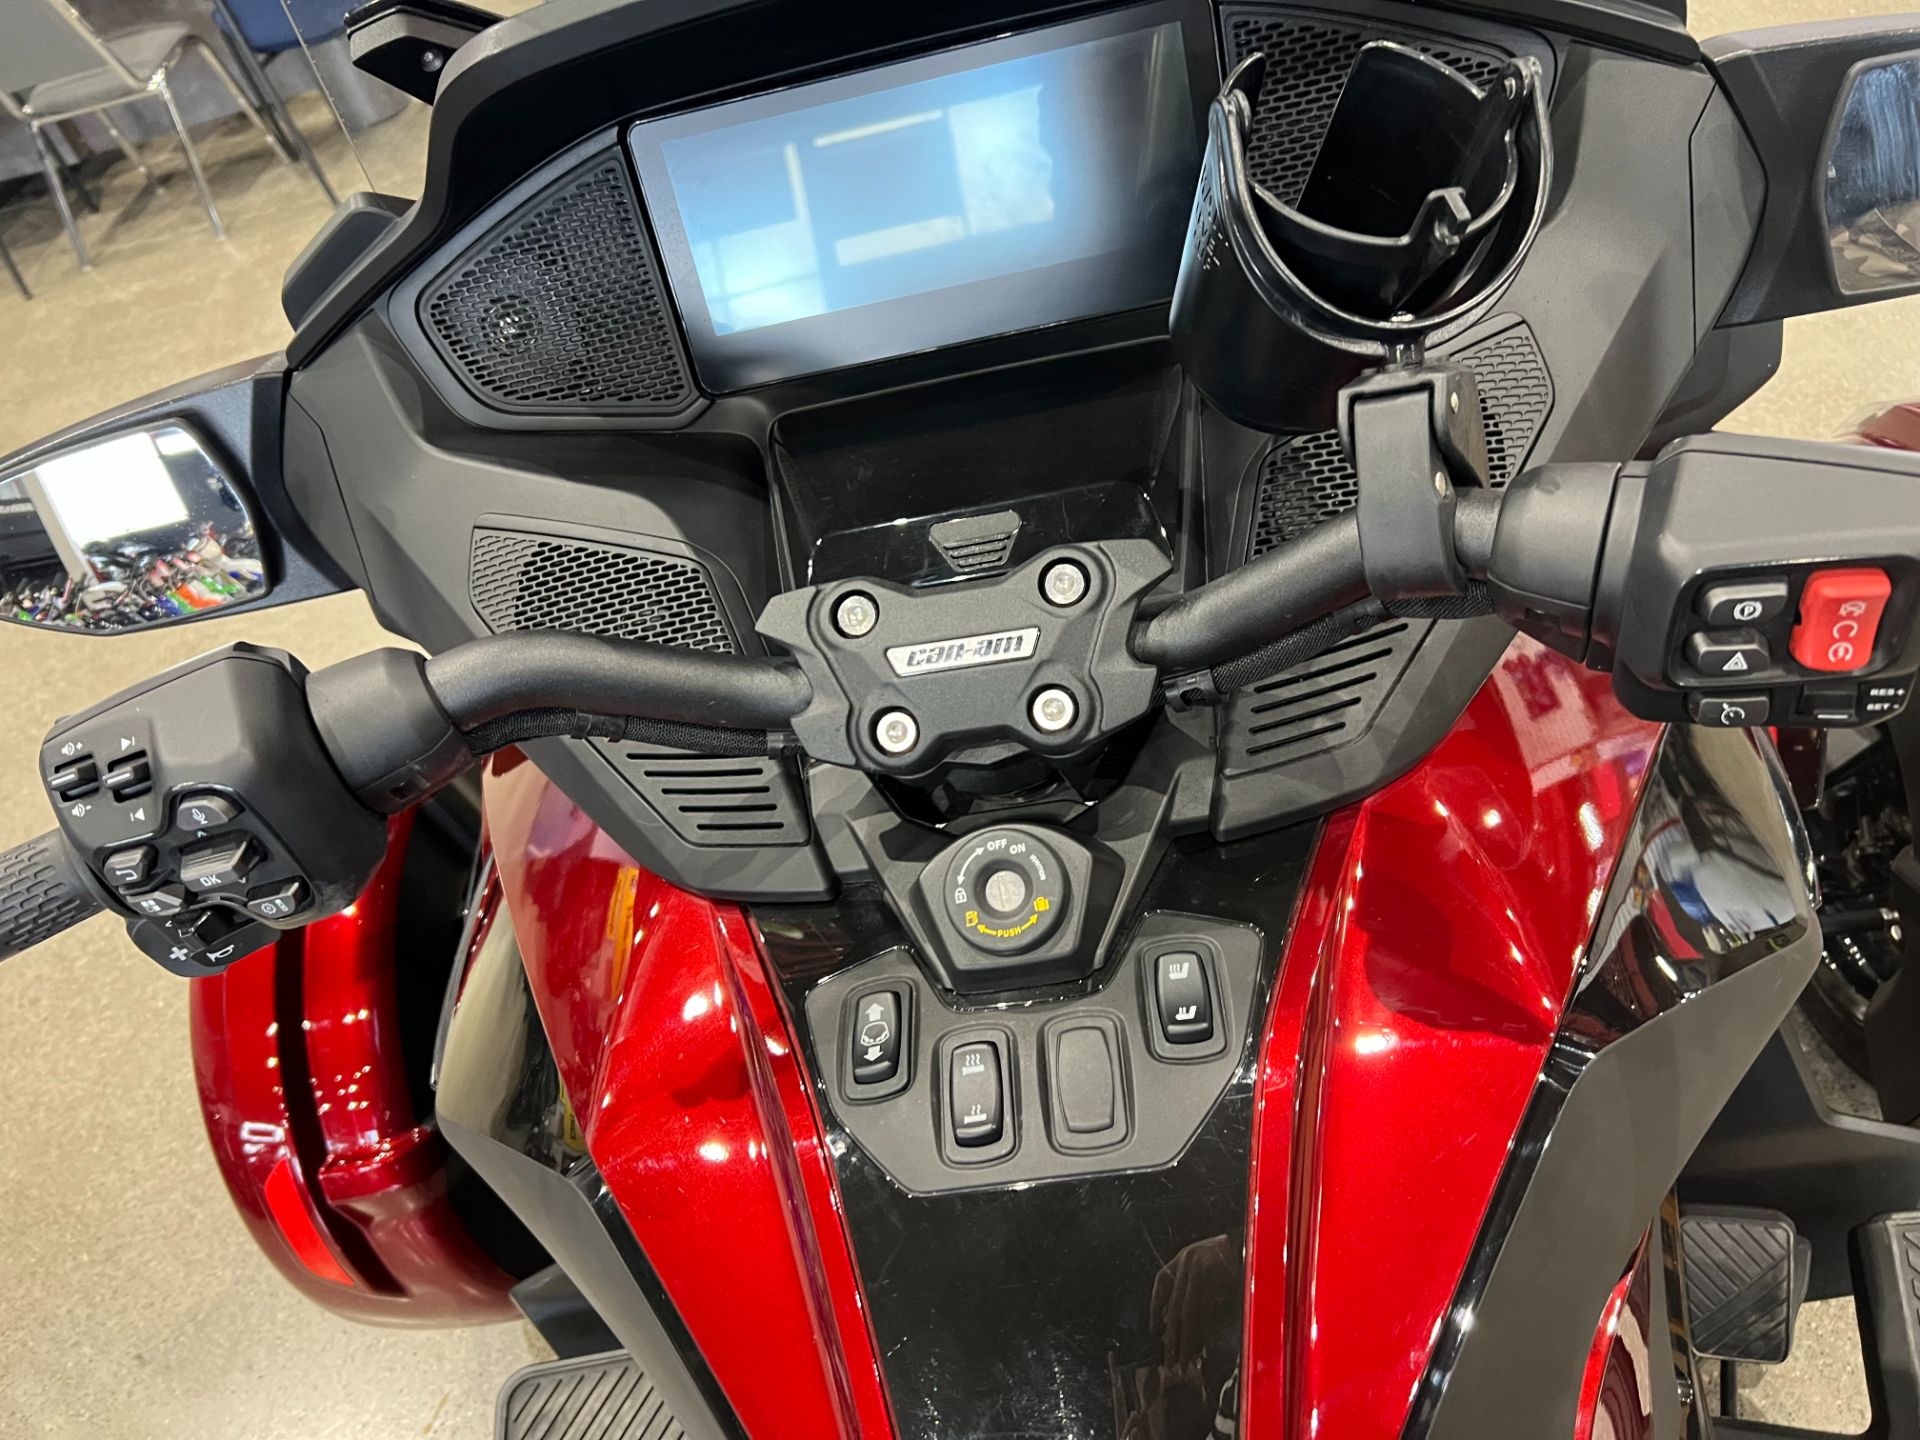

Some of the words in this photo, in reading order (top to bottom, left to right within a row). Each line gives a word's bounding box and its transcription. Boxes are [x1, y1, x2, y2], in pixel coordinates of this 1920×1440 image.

[906, 635, 1024, 667] can-am
[986, 838, 1008, 851] OFF
[1009, 842, 1026, 855] ON
[199, 873, 222, 887] OK
[997, 926, 1022, 938] PUSH
